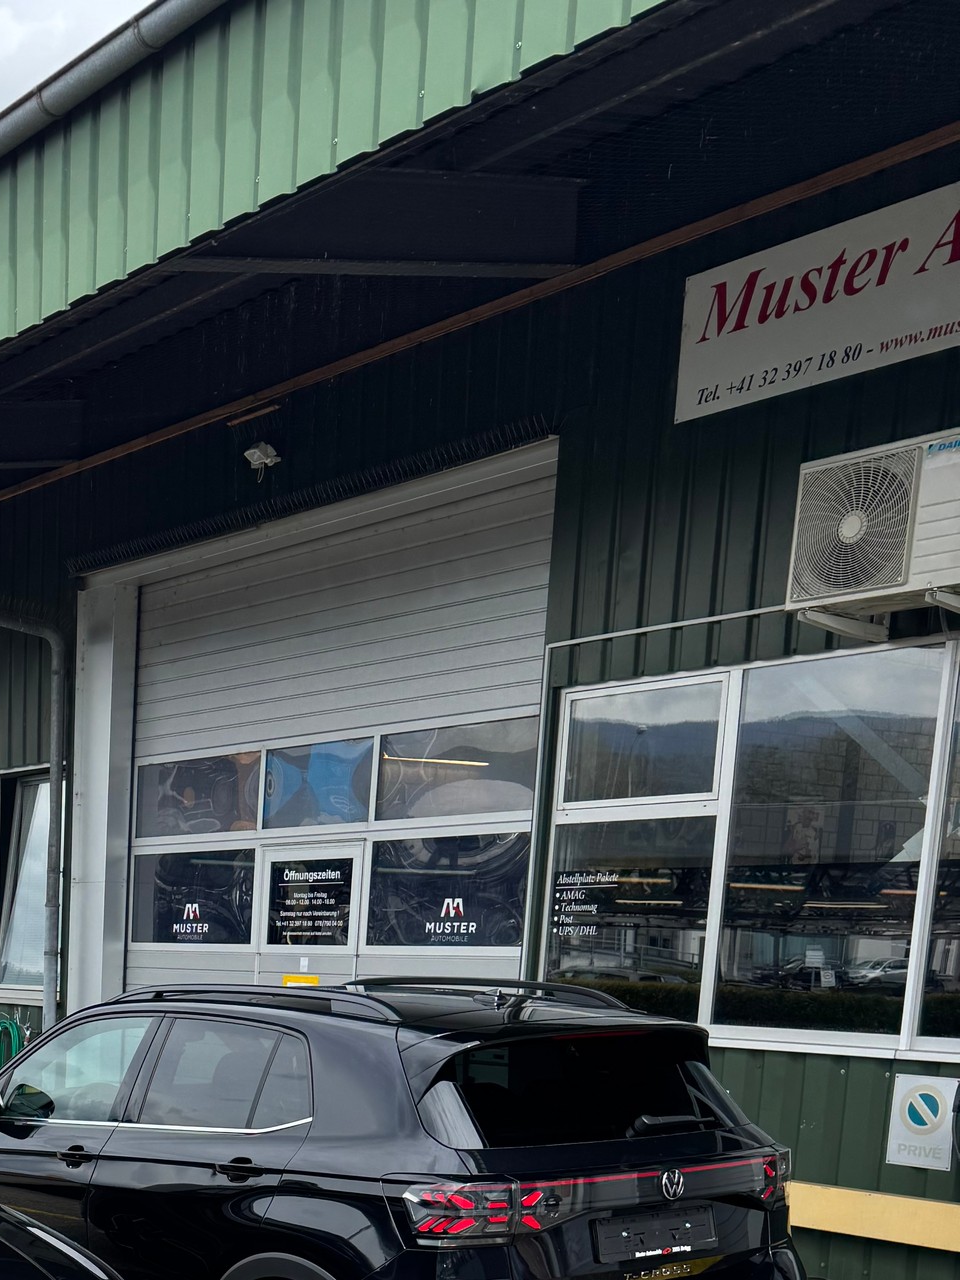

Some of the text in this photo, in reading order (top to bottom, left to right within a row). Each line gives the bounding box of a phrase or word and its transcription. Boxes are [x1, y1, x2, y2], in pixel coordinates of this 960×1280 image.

[695, 236, 910, 344] Muster
[696, 383, 720, 406] Tel.
[726, 373, 755, 395] +41
[758, 367, 779, 388] 32
[781, 356, 813, 382] 397
[816, 349, 837, 372] 18
[841, 342, 863, 365] 80
[283, 868, 341, 882] Öffnungszeiten
[556, 872, 619, 886] Abstellplatz Pakete
[560, 890, 586, 900] AMAG
[560, 901, 598, 914] Technomag
[559, 914, 574, 924] Post
[172, 923, 209, 933] MUSTER
[425, 921, 477, 934] MUSTER
